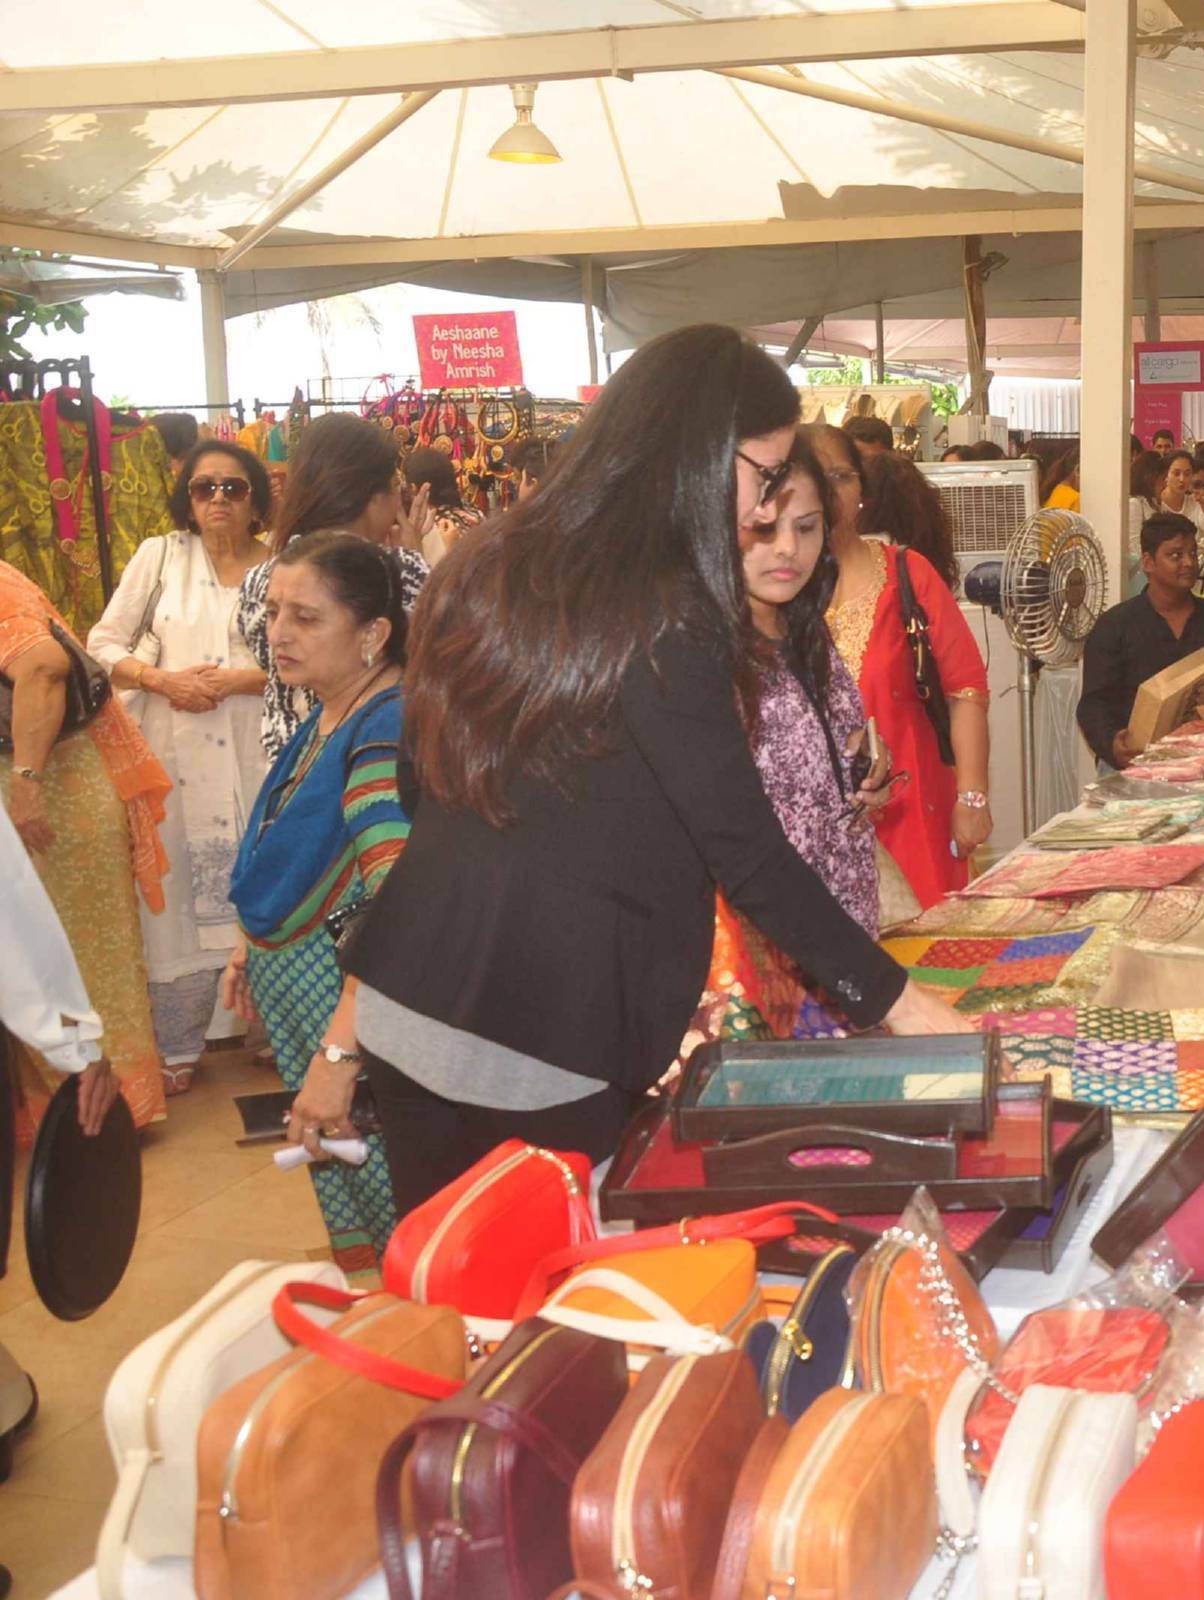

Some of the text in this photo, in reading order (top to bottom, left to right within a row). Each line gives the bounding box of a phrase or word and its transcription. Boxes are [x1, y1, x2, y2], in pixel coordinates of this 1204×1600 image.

[432, 324, 498, 341] Aeshaane
[431, 342, 504, 364] by Neesha
[446, 361, 496, 379] Amrish
